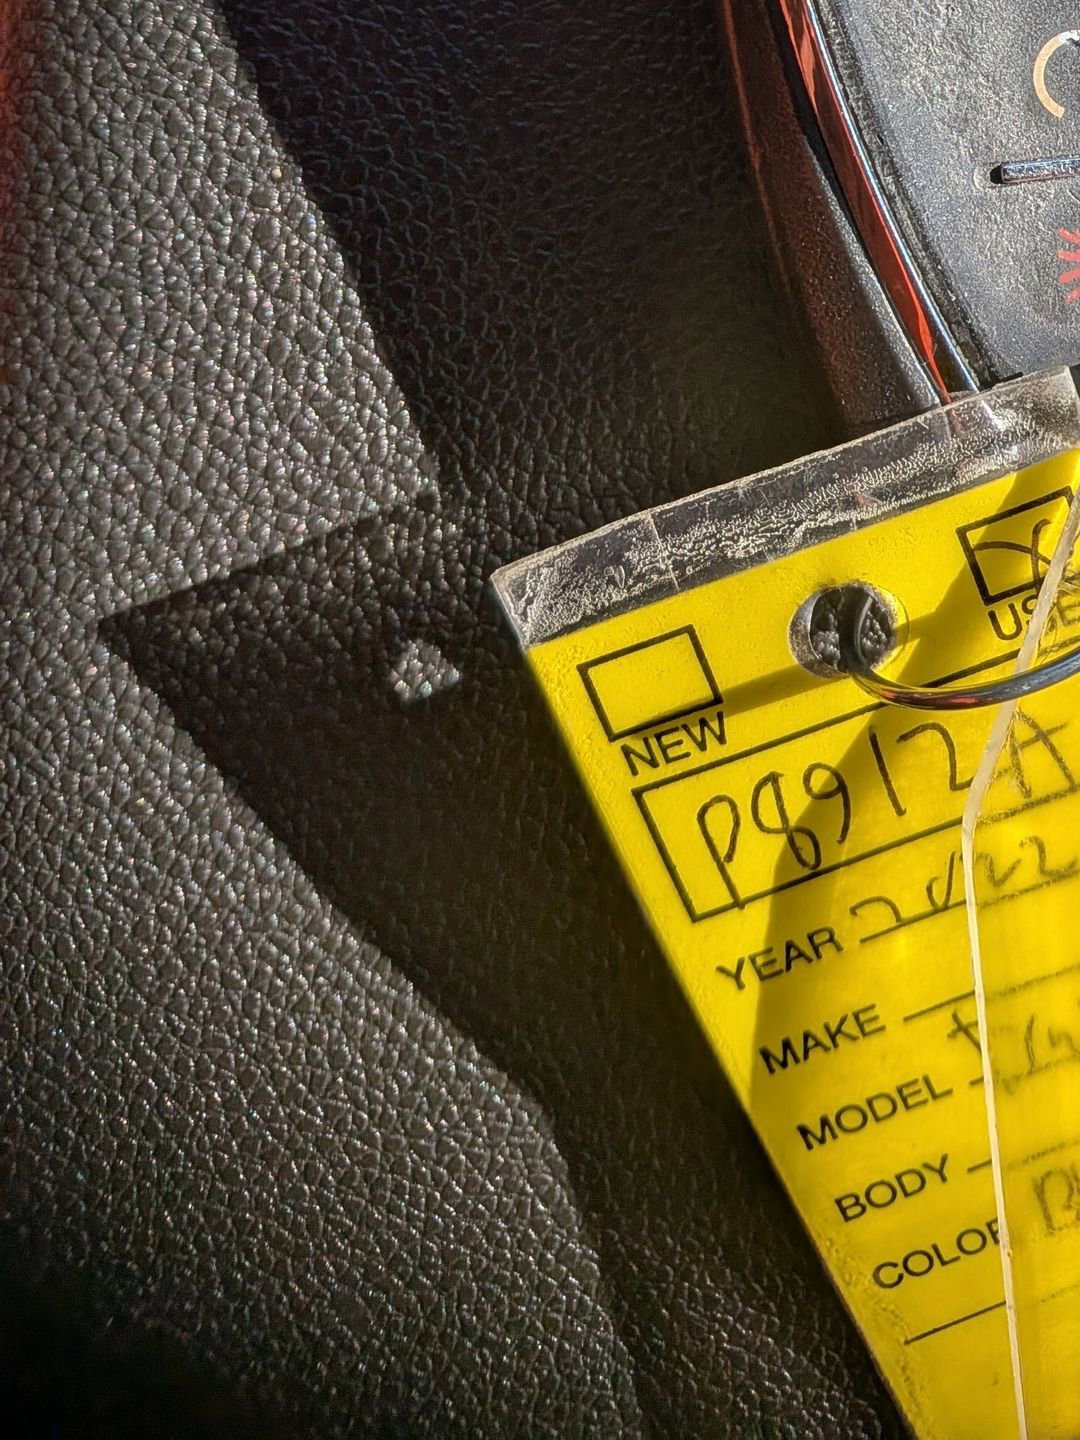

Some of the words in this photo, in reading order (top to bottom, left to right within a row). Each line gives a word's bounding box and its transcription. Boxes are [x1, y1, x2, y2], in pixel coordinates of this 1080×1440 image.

[620, 710, 728, 777] NEW
[715, 926, 844, 990] YEAR
[758, 1003, 887, 1076] MAKE
[796, 1074, 954, 1151] MODEL
[834, 1152, 949, 1223] BODY
